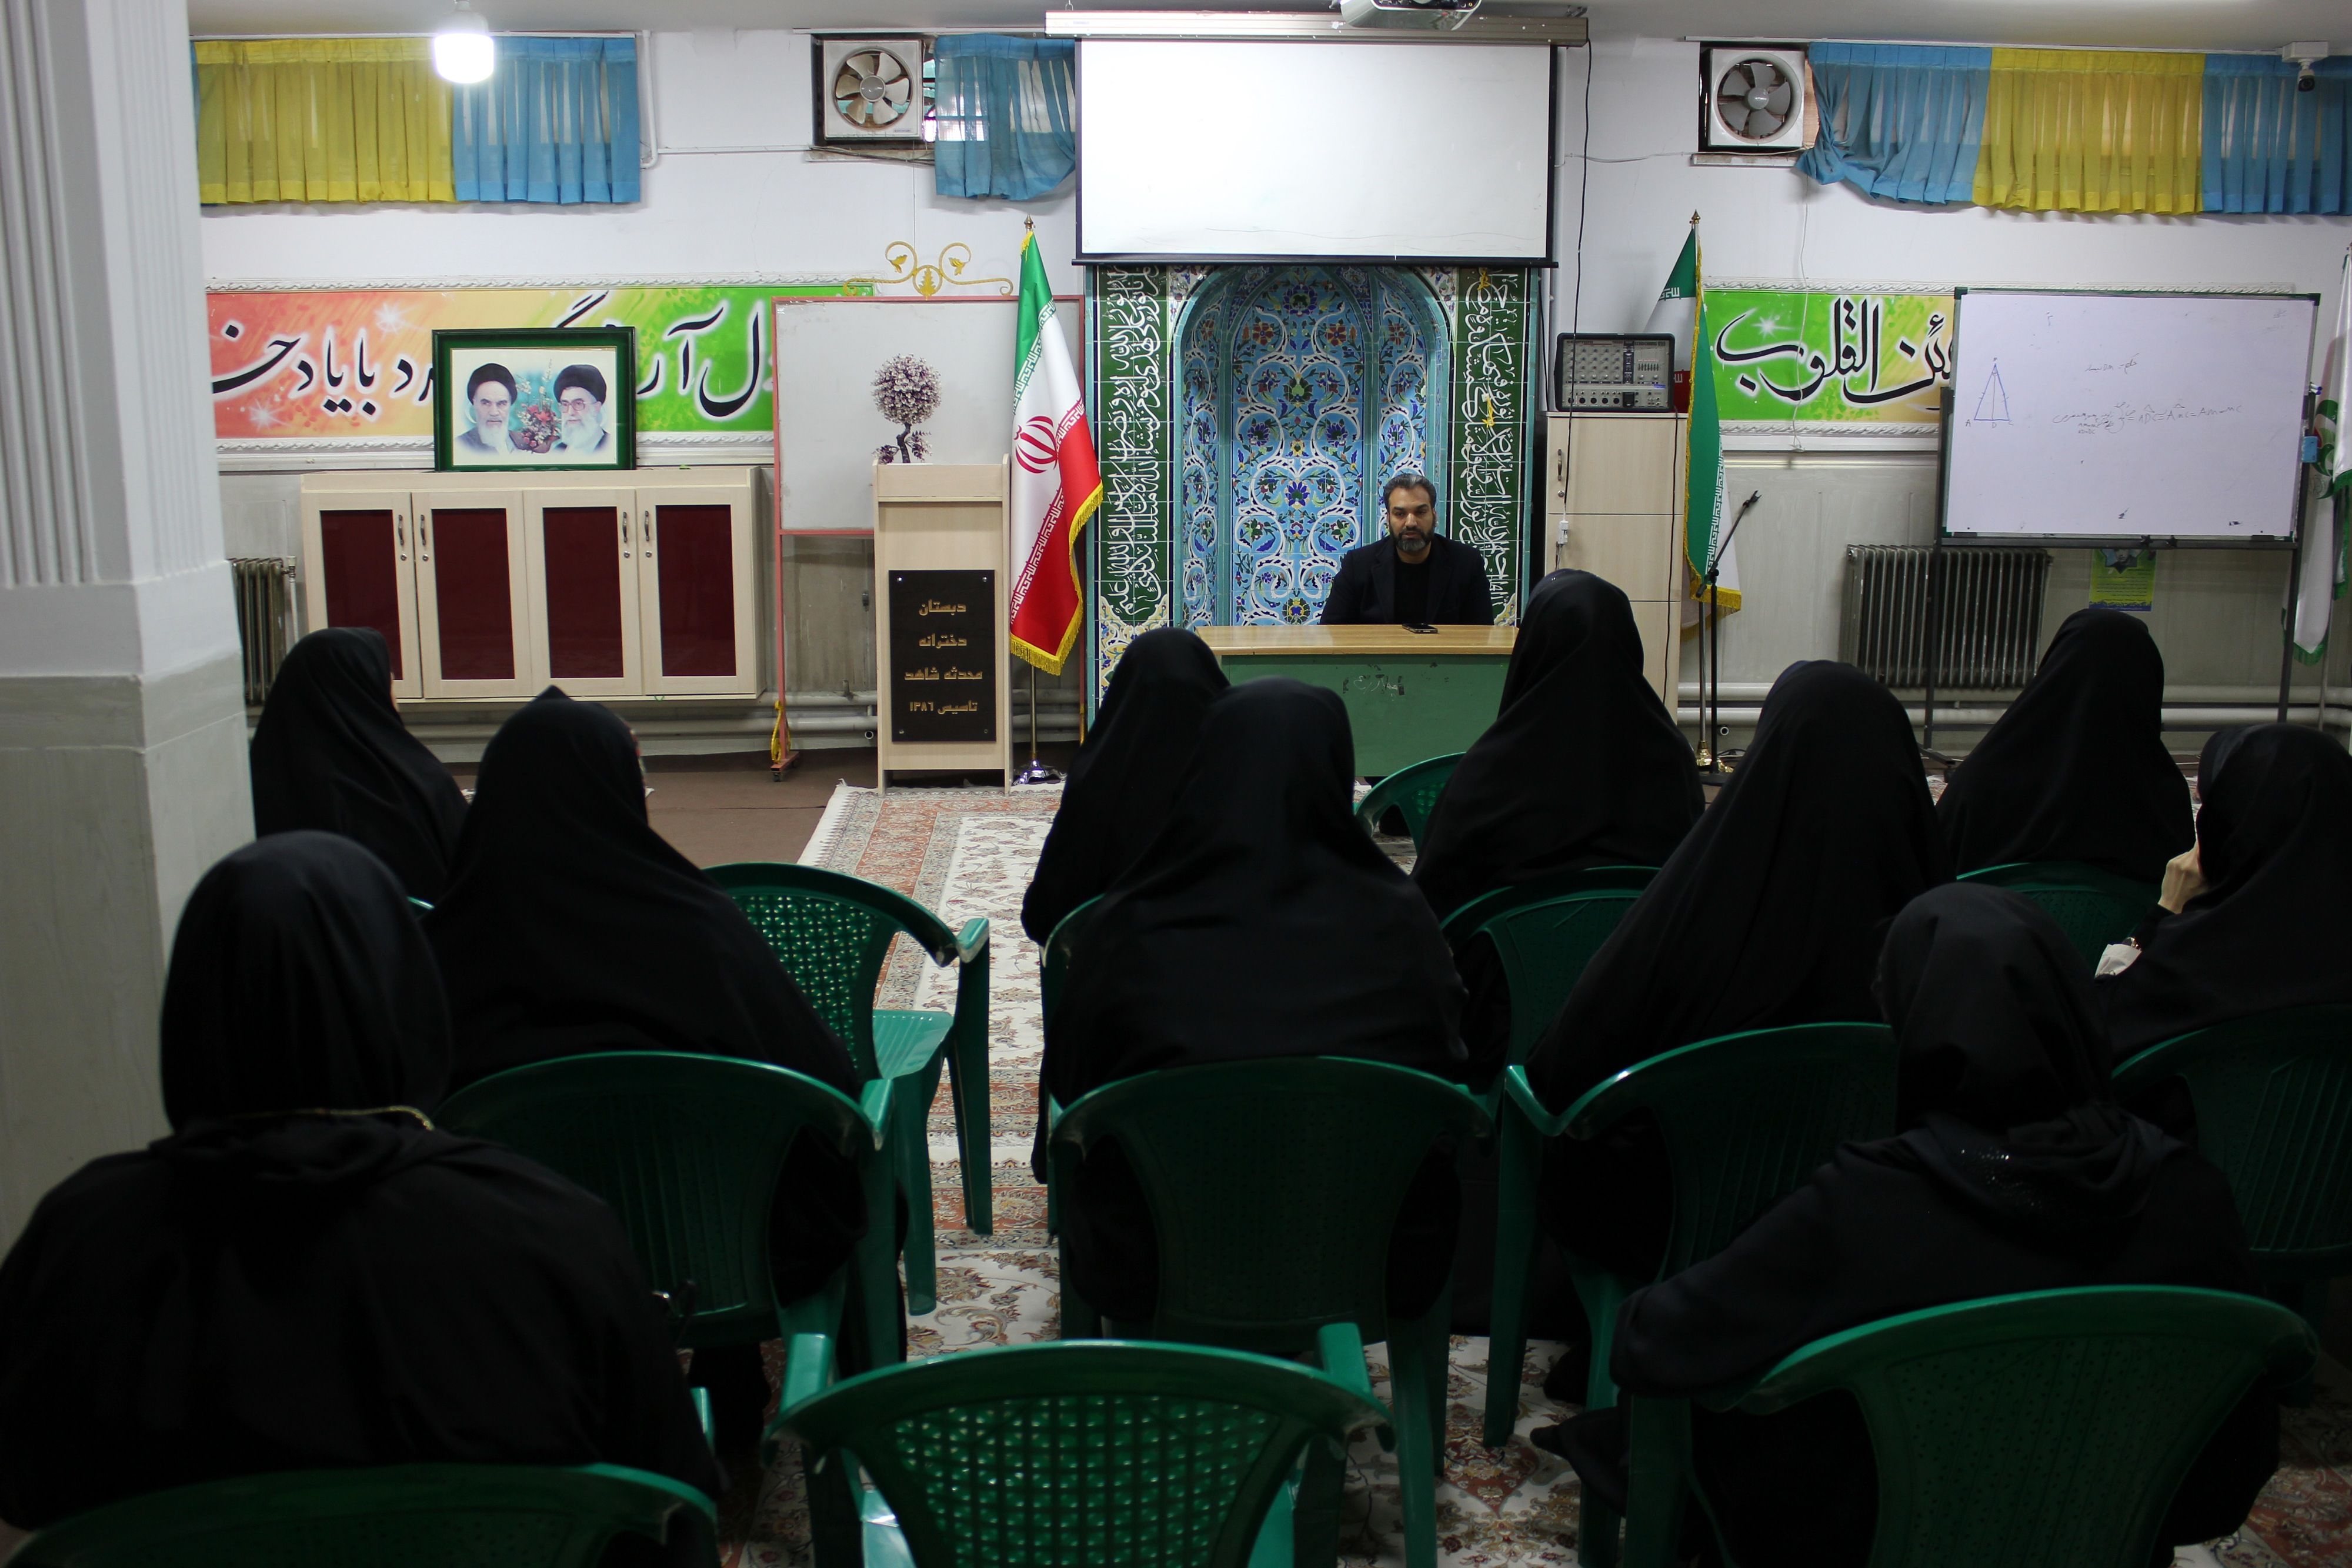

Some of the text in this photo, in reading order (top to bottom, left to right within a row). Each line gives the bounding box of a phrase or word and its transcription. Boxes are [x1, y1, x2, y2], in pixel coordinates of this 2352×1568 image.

[1716, 297, 1880, 401] القلوب
[699, 312, 760, 418] ل
[919, 599, 966, 616] دبستان
[919, 633, 967, 649] دخترانه
[904, 666, 983, 680] محدثه شاهد
